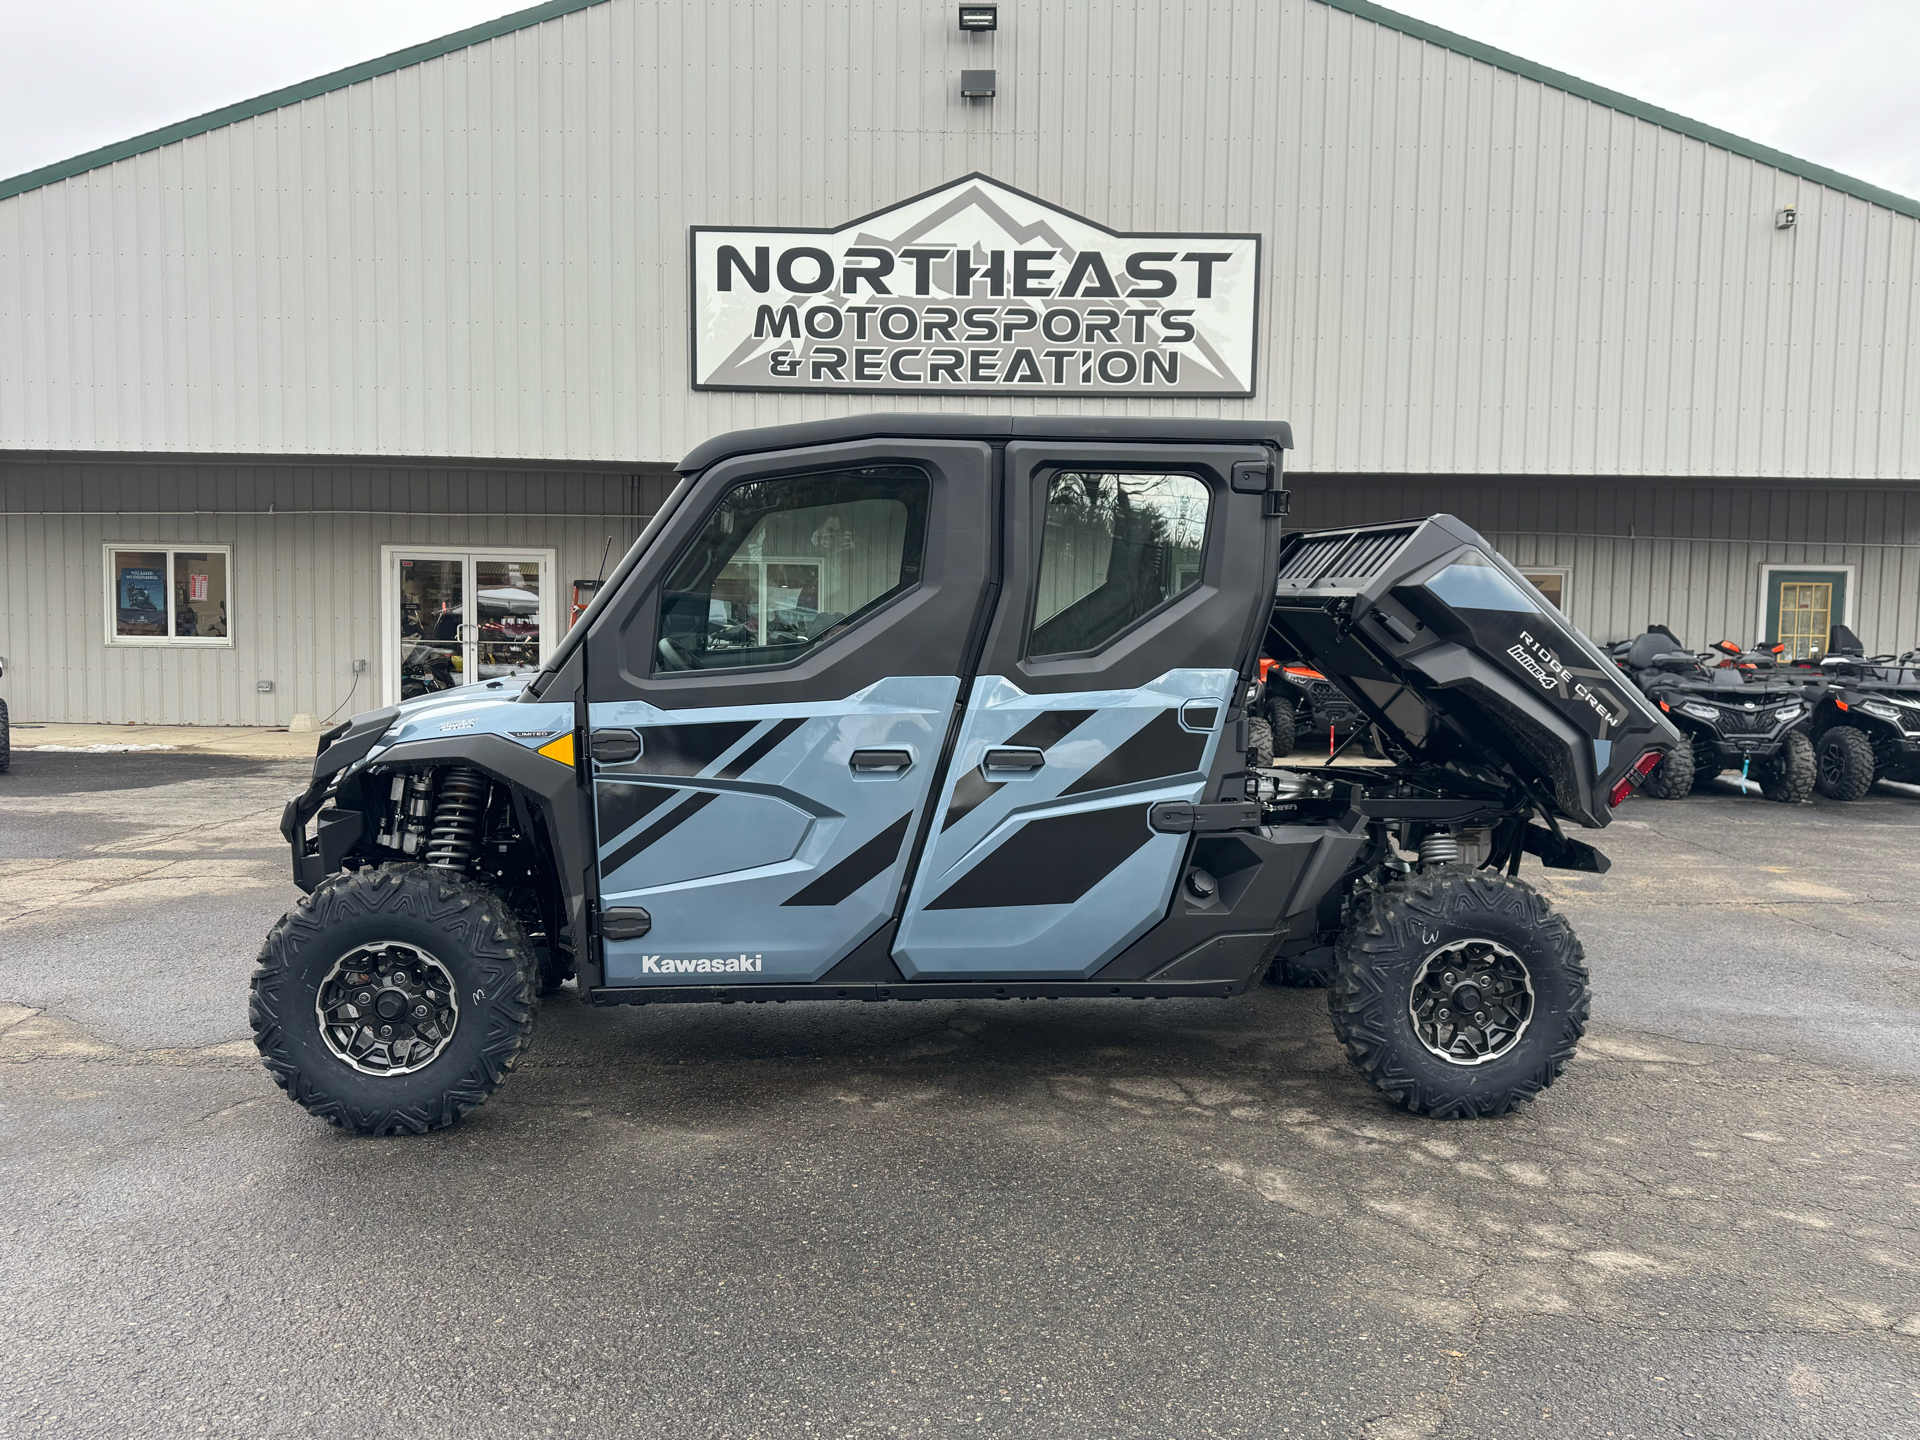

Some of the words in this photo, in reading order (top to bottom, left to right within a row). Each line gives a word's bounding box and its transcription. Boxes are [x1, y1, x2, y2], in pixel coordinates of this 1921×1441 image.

[717, 245, 1233, 299] NORTHEAST
[753, 304, 1195, 343] MOTORSPORTS
[1519, 630, 1573, 683] RIDGE
[1574, 683, 1618, 727] CREW
[642, 954, 762, 974] Kawasaki
